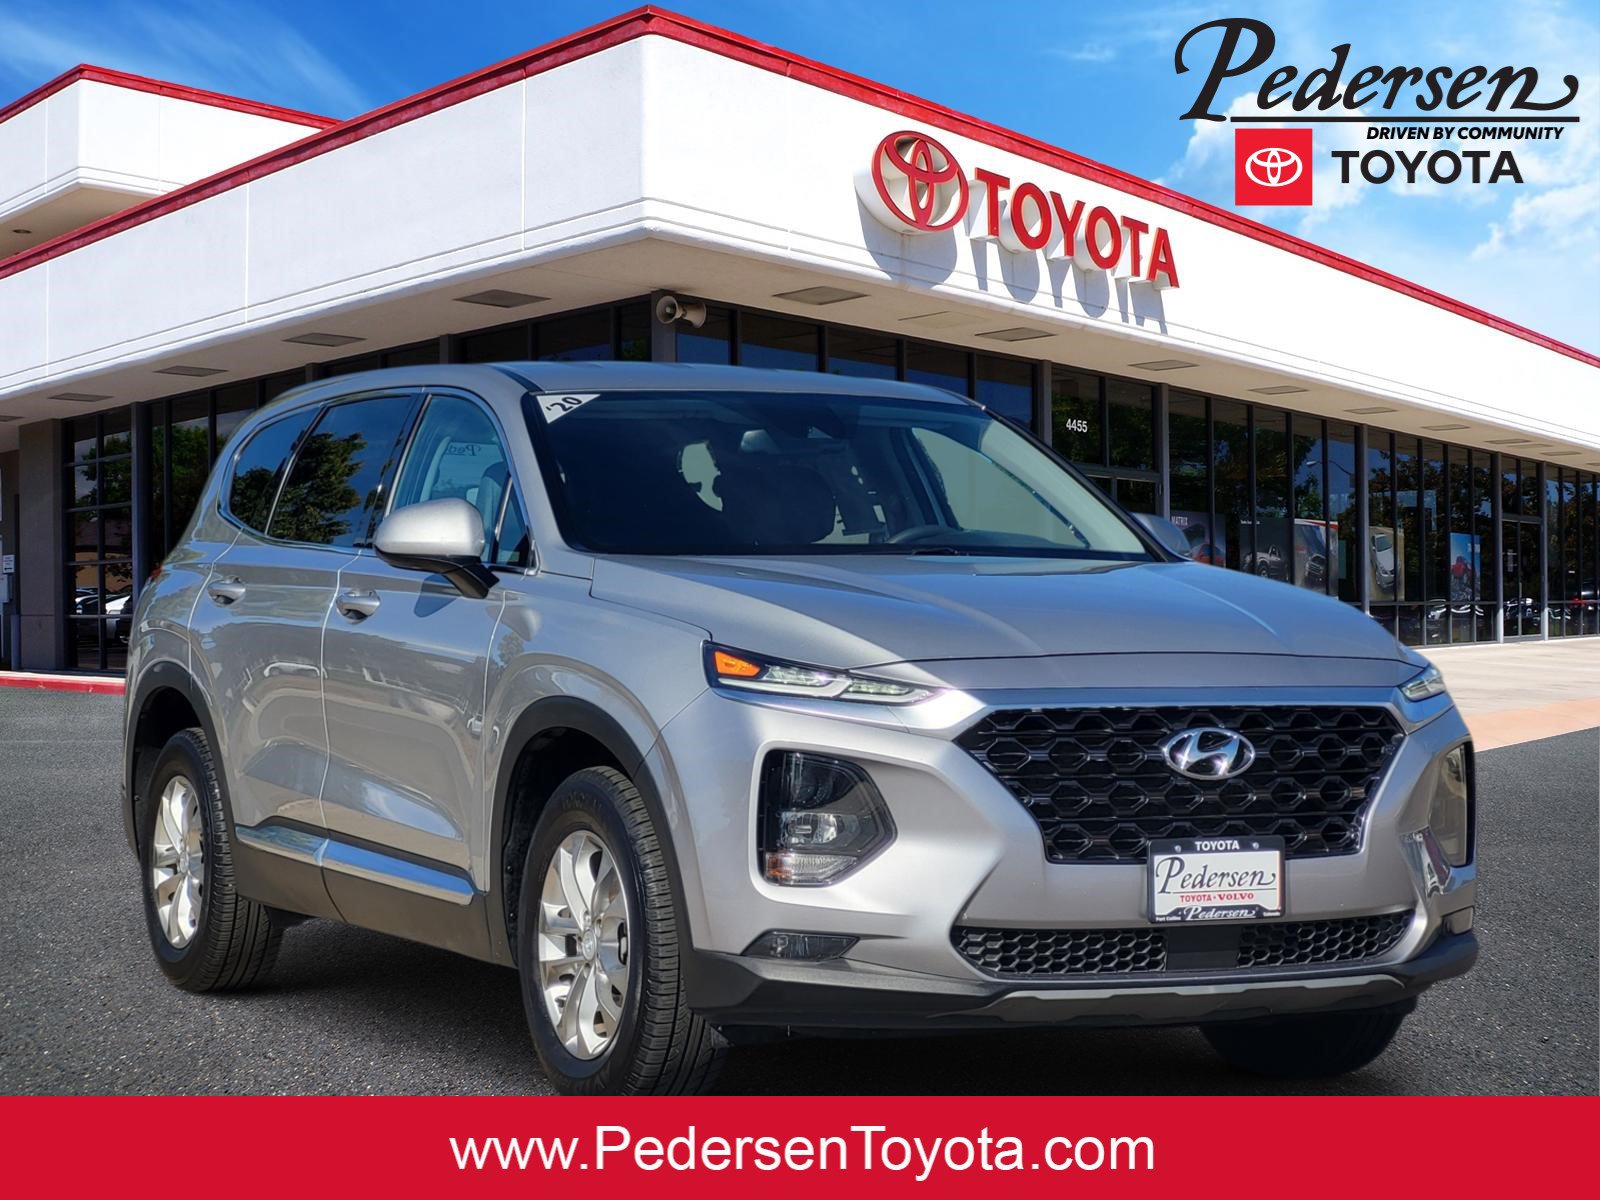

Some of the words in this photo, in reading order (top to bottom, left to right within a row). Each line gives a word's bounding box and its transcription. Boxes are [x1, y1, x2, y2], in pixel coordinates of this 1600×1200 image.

[975, 168, 1179, 288] TOYOTA
[545, 396, 582, 411] '20
[1066, 418, 1088, 433] 4455
[1195, 840, 1240, 851] TOYOTA
[1155, 856, 1276, 894] Pedersen
[1180, 894, 1212, 903] TOYOTA
[1183, 905, 1256, 920] Pedersen
